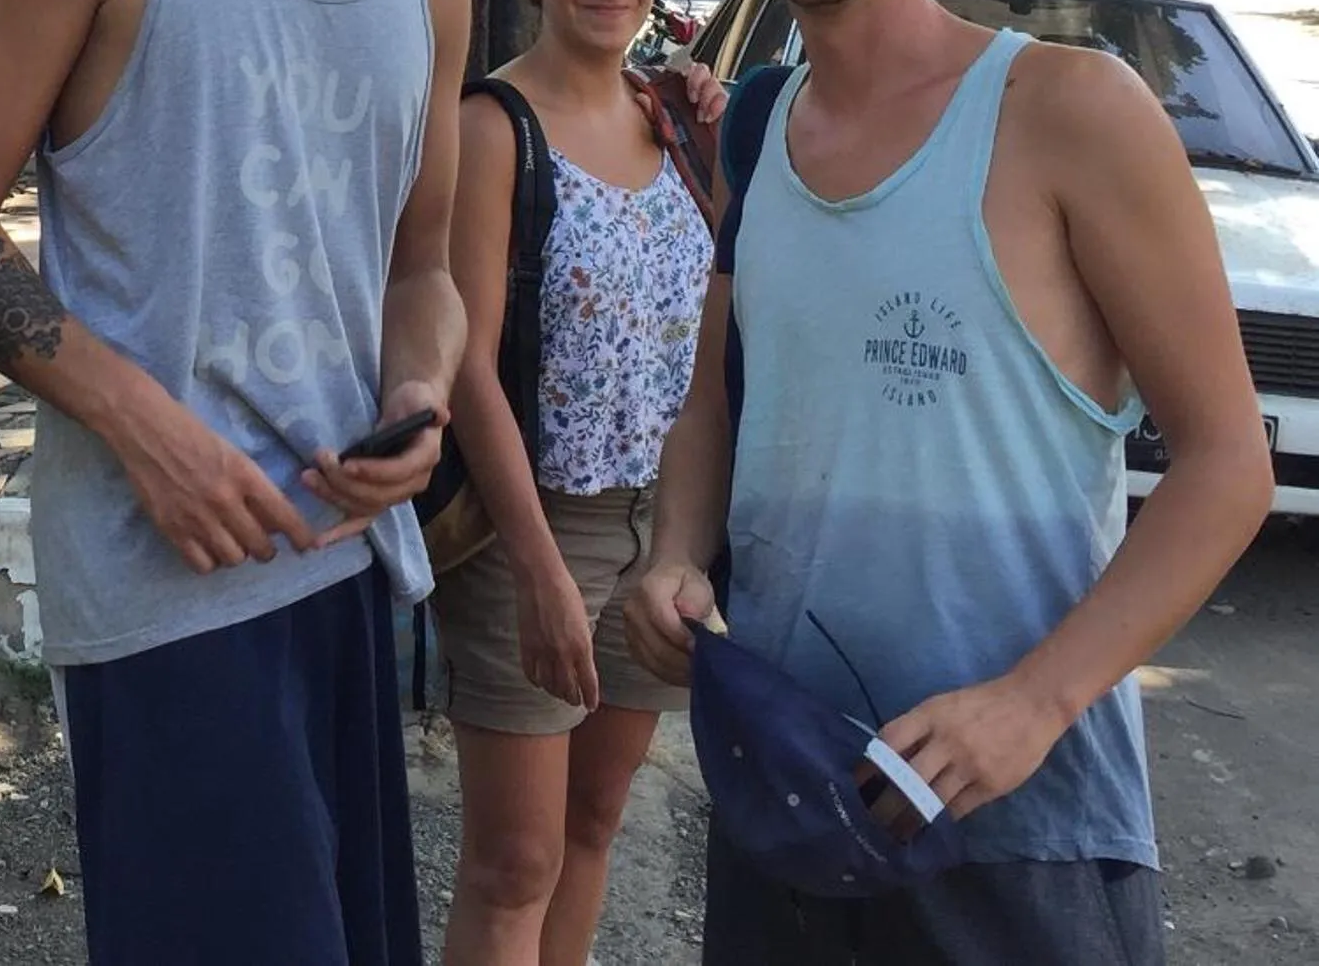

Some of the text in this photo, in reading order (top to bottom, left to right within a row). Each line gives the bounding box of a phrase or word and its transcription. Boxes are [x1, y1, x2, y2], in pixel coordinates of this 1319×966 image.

[239, 55, 373, 133] YOU
[240, 143, 353, 216] CAN
[194, 319, 353, 385] HOM
[864, 339, 967, 376] PRINCE EDWARD
